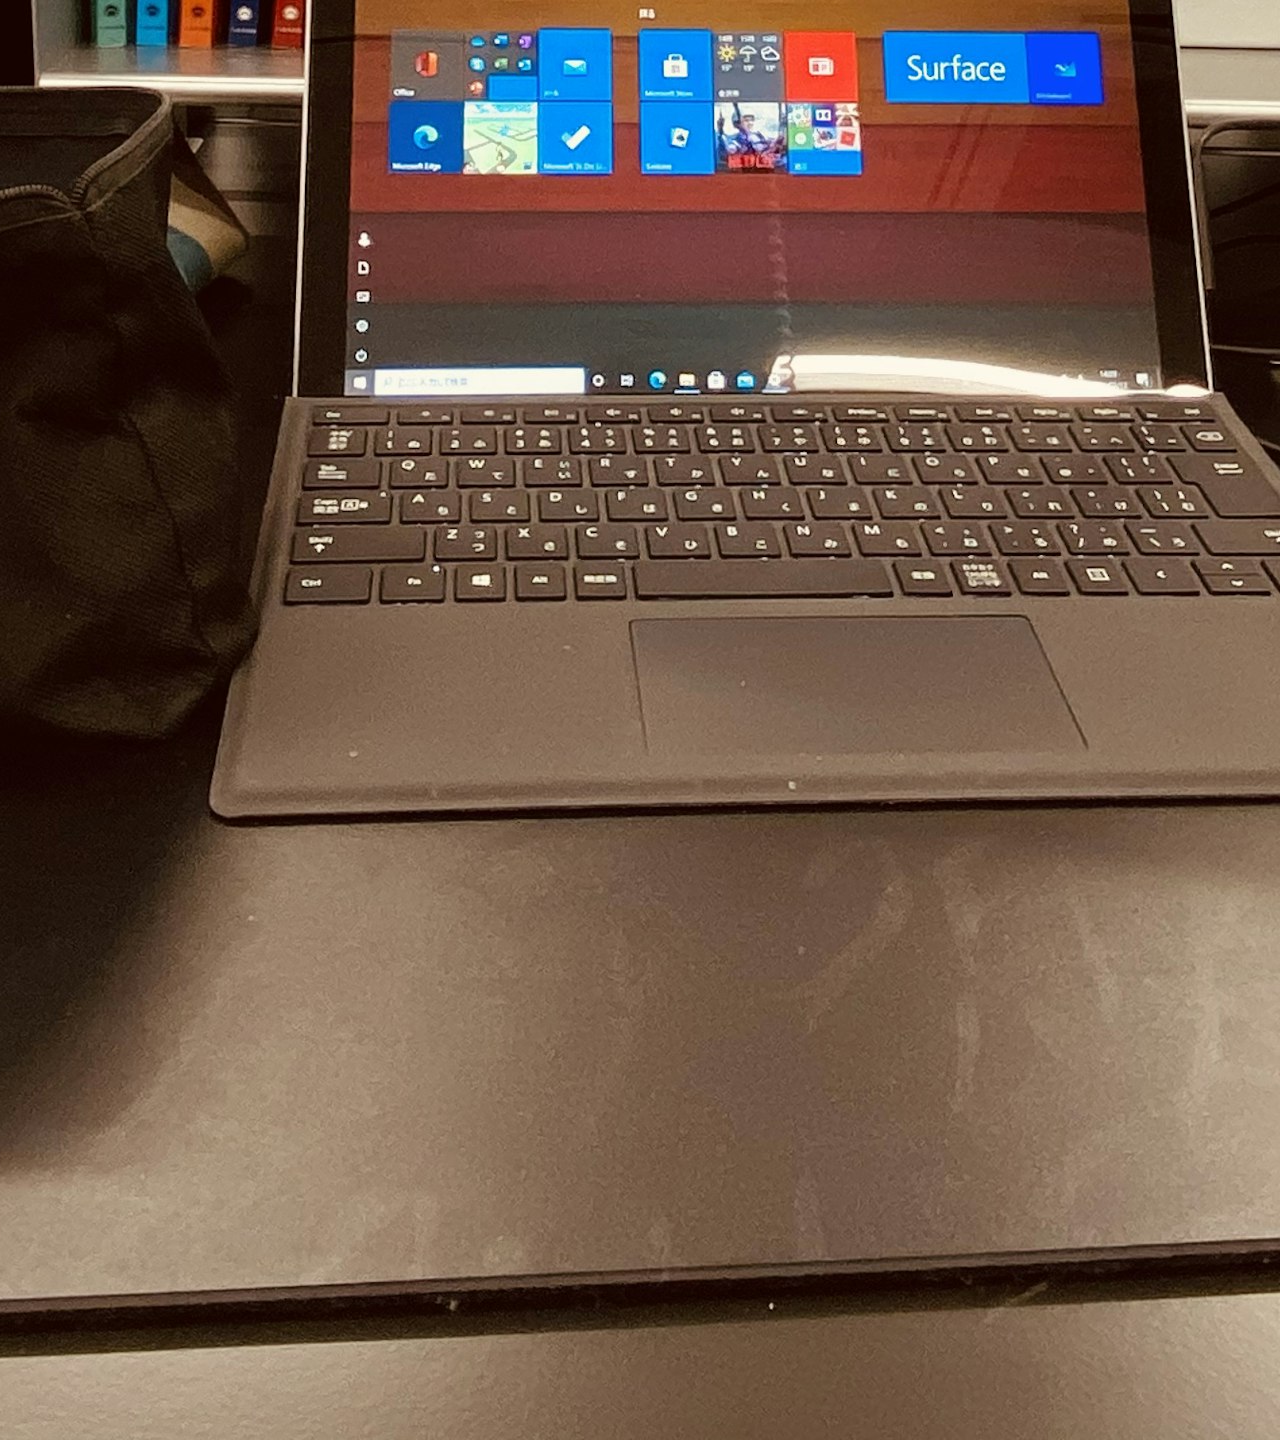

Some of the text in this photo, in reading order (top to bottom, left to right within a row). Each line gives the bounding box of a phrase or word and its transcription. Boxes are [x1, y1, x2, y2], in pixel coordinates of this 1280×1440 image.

[907, 54, 1006, 81] Surface
[401, 460, 415, 471] Q
[469, 459, 485, 469] W
